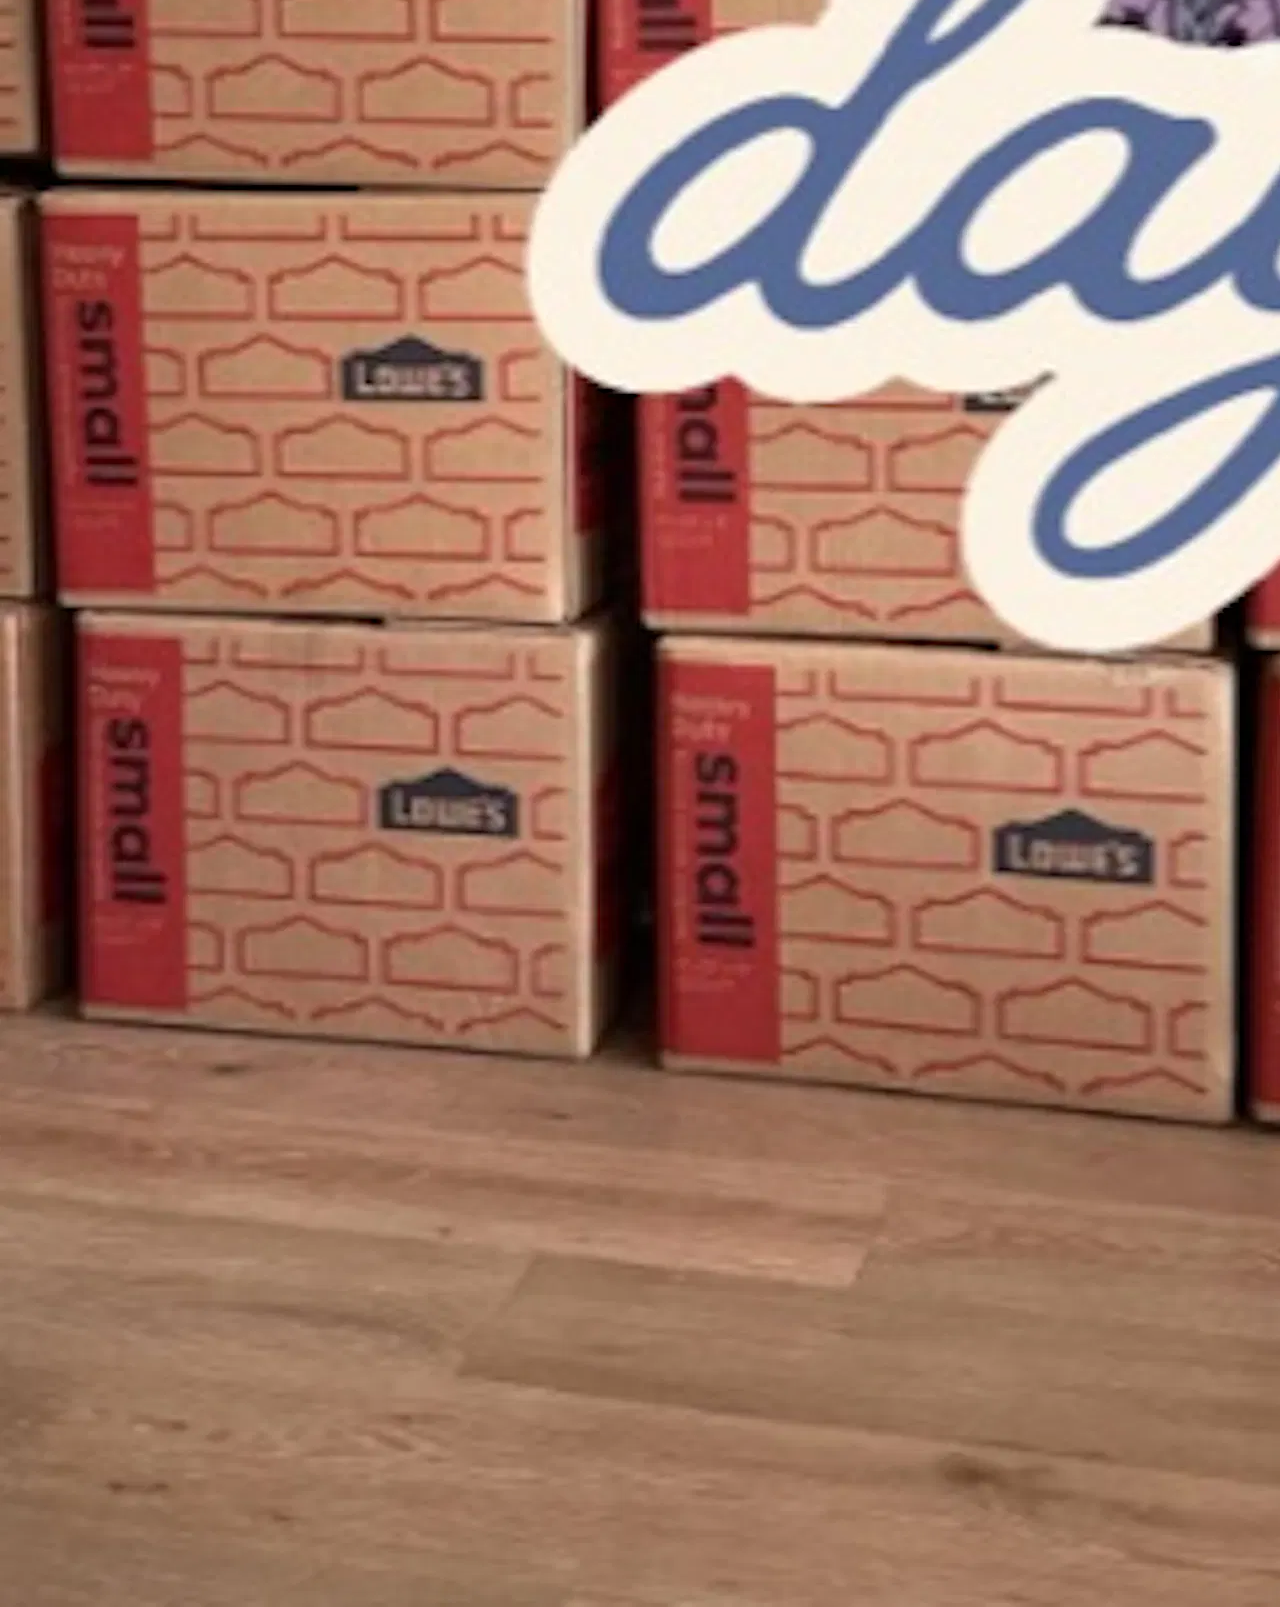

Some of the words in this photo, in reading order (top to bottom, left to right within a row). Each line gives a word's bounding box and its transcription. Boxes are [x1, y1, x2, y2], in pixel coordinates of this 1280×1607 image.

[78, 299, 140, 489] small
[676, 383, 736, 504] all
[109, 718, 168, 908] small
[696, 752, 757, 952] small
